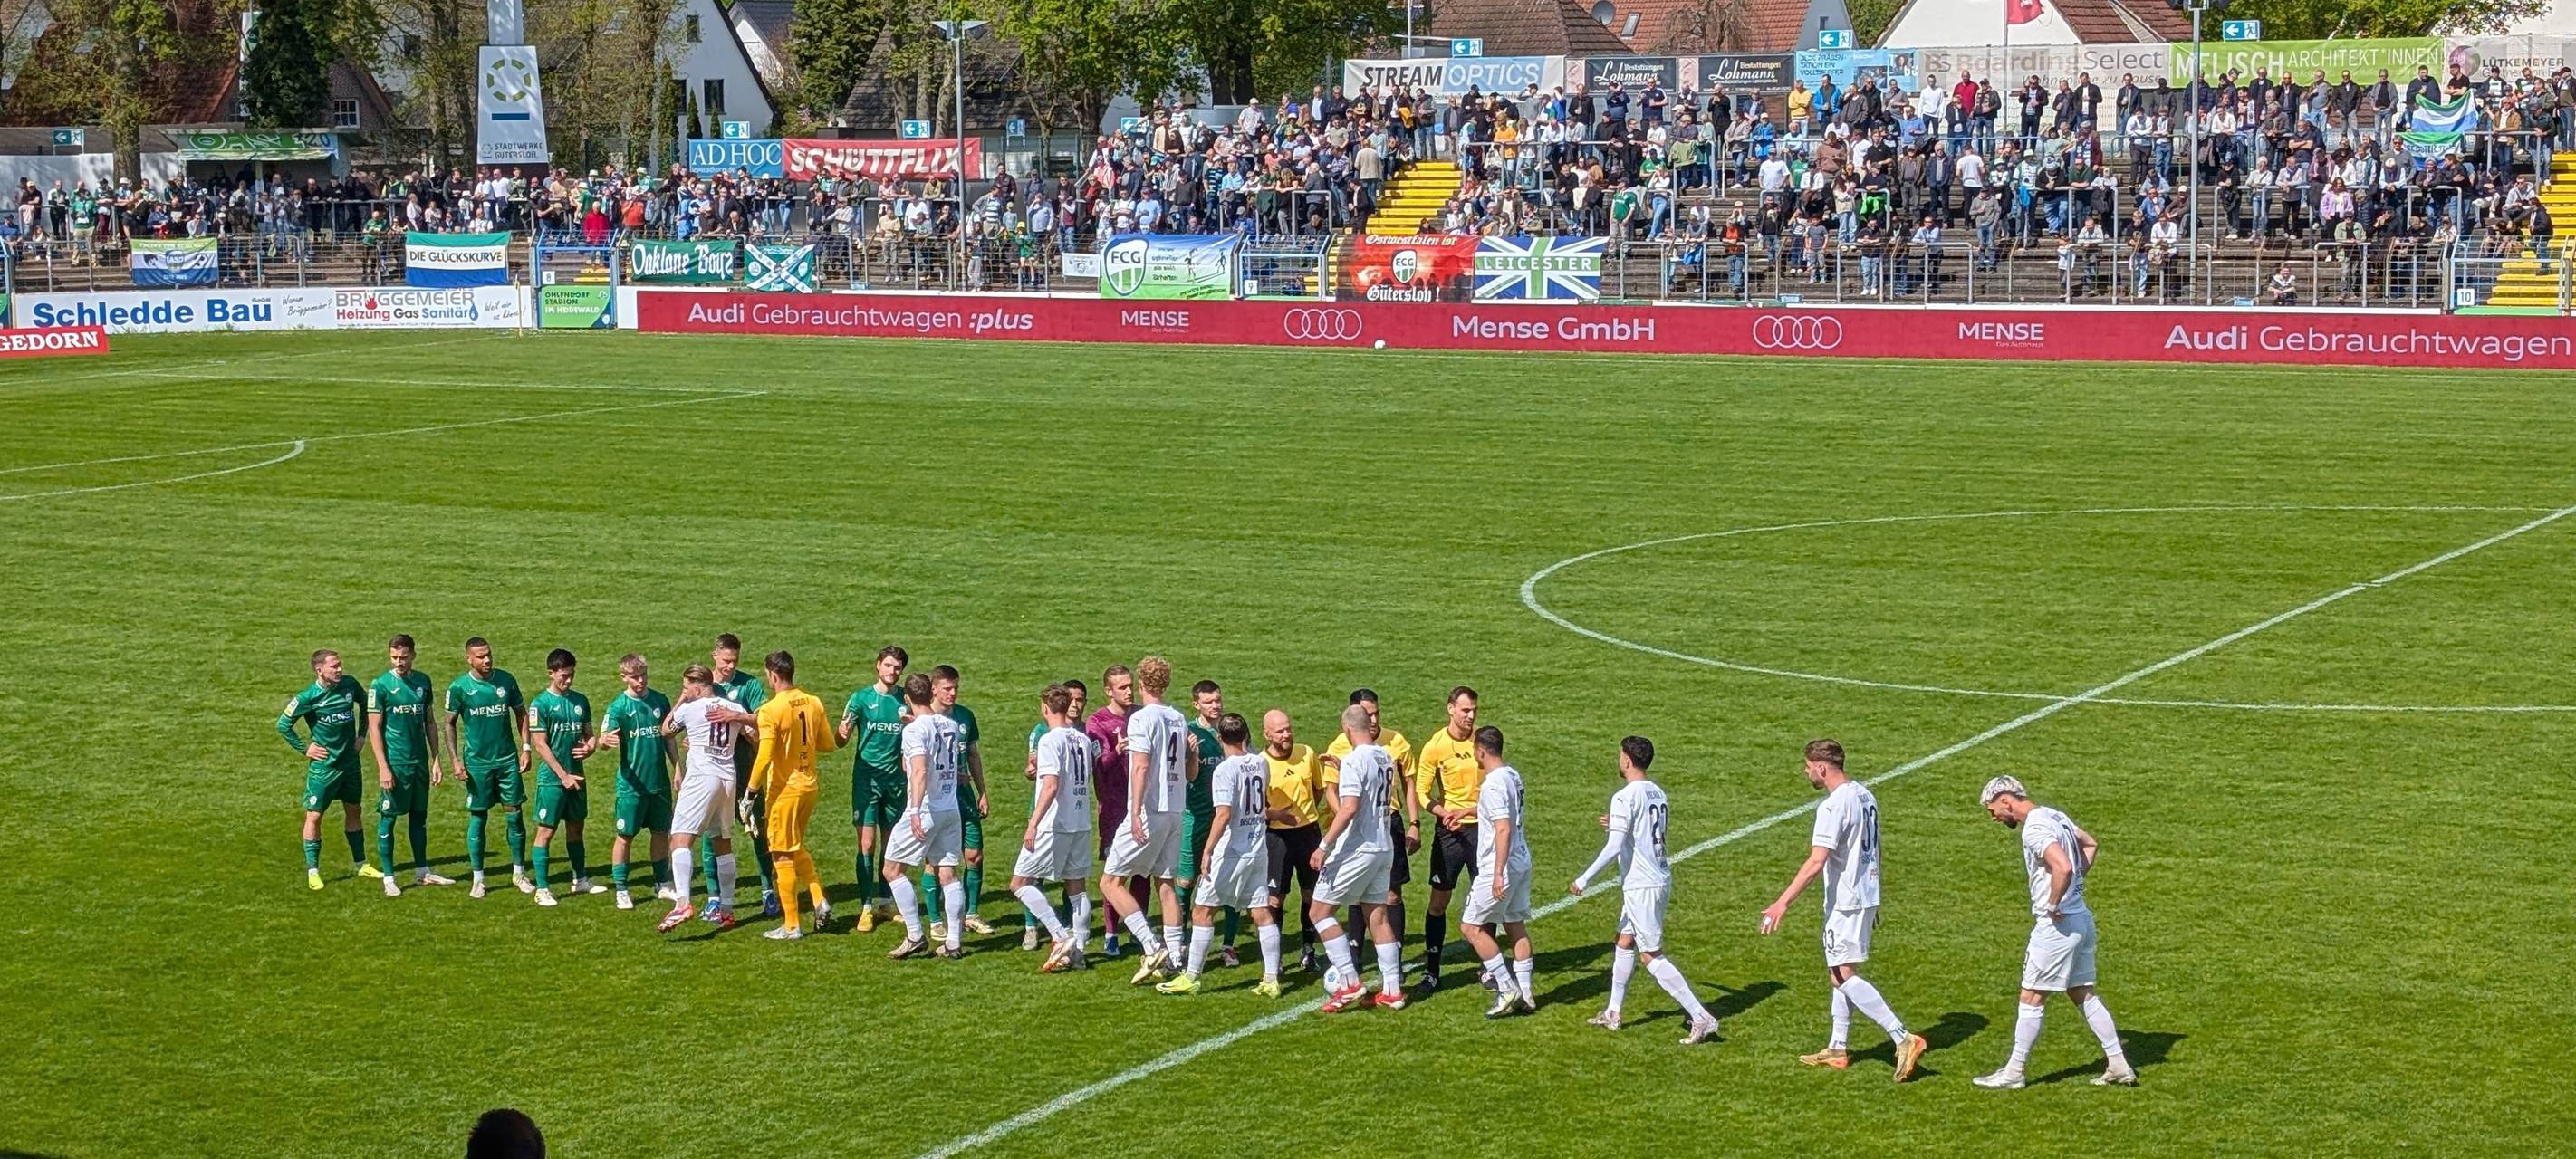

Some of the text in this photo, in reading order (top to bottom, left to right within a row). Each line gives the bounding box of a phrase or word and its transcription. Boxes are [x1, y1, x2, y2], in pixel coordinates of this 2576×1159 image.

[1708, 58, 1775, 81] Lohmann
[2084, 49, 2163, 70] Select
[2483, 56, 2564, 67] LÜTKEMEYER
[1362, 62, 1539, 87] STREAM OPTICS
[1594, 61, 1658, 82] Lohmann
[692, 142, 782, 166] AD HOC
[791, 147, 961, 174] SCHÜTTFLIX
[409, 249, 502, 263] DIE GLÜCKSKURVE
[1111, 250, 1141, 263] FCG
[1396, 258, 1414, 267] FCG
[1484, 256, 1591, 271] LEICESTER
[2458, 290, 2472, 303] 10
[33, 299, 272, 327] Schledde Bau
[337, 307, 468, 321] Heizung Gas Sanitär
[688, 302, 745, 323] Audi
[752, 302, 961, 333] Gebrauchtwagen
[1121, 311, 1189, 326] MENSE
[1453, 315, 1656, 341] Mense GmbH
[1958, 322, 2044, 340] MENSE
[0, 331, 98, 351] GEDORN
[2164, 325, 2571, 361] Audi Gebrauchtwagen
[799, 710, 808, 746] 1
[935, 731, 956, 771] 27
[1167, 731, 1177, 770] 4
[1198, 756, 1225, 766] MEN
[1245, 776, 1264, 814] 13
